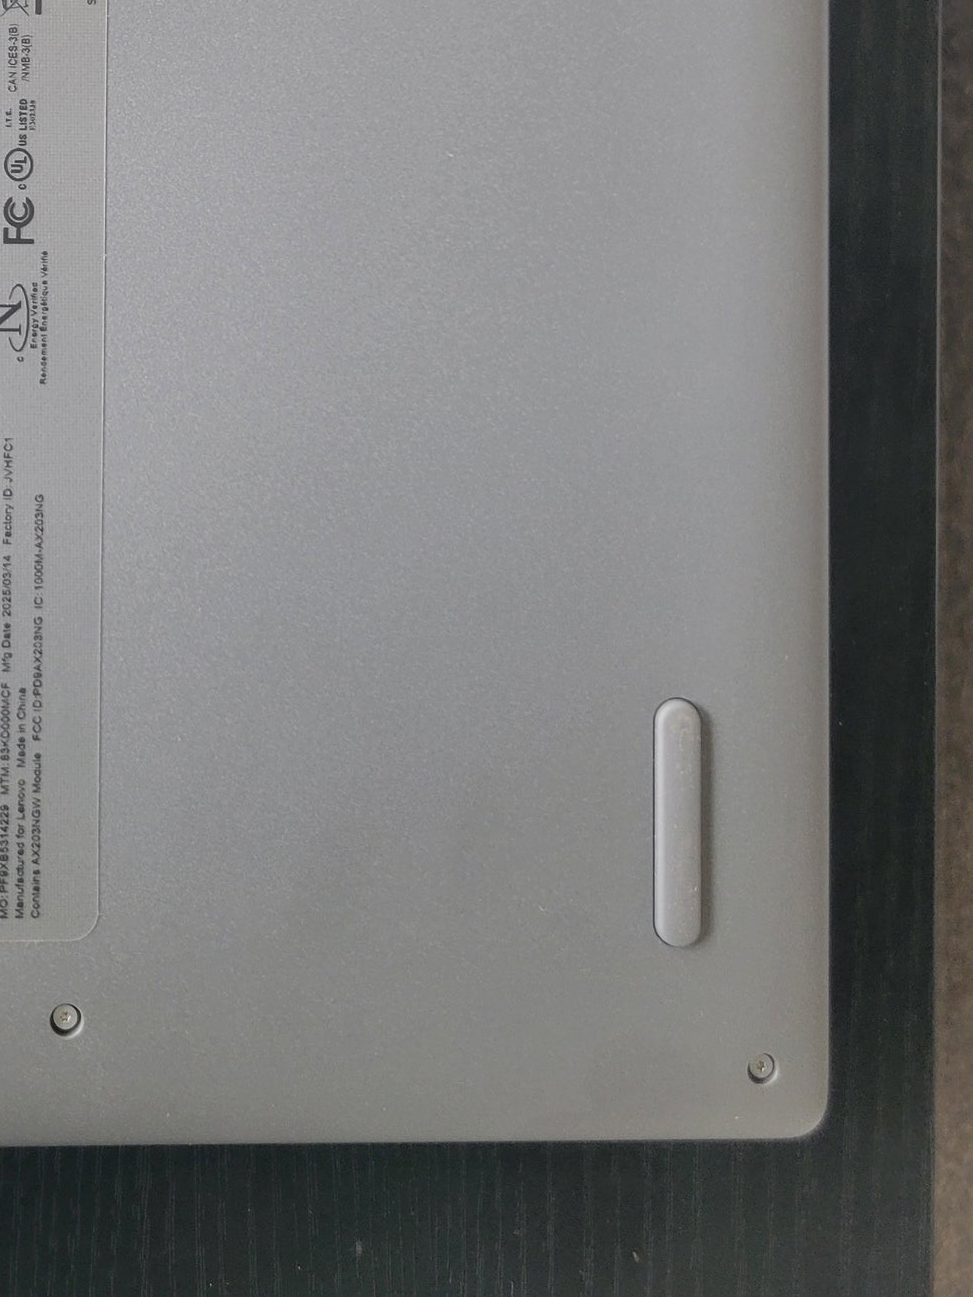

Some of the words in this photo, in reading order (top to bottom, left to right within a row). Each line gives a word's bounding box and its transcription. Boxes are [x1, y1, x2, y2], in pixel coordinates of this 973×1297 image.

[8, 24, 19, 68] ICES-3(B)
[21, 34, 33, 82] /NMB-3(B)
[8, 72, 17, 92] CAN
[19, 99, 28, 131] LISTED
[18, 134, 27, 146] US
[30, 282, 38, 316] Verified
[30, 318, 39, 349] Energy
[39, 334, 47, 384] Rendement
[3, 437, 14, 483] JVHFC1
[2, 504, 14, 545] Factory
[1, 555, 12, 617] 2025/03/14
[1, 622, 11, 648] Date
[1, 652, 13, 672] Mfg
[16, 687, 27, 720] China
[16, 724, 26, 733] in
[32, 716, 42, 741] FCC
[16, 736, 26, 768] Made
[0, 763, 10, 795] MTM:
[31, 753, 42, 793] Module
[15, 779, 26, 820] Lenovo
[15, 823, 25, 839] for
[30, 797, 41, 866] AX203NGW
[14, 842, 25, 919] Manufactured
[30, 869, 41, 919] Contains
